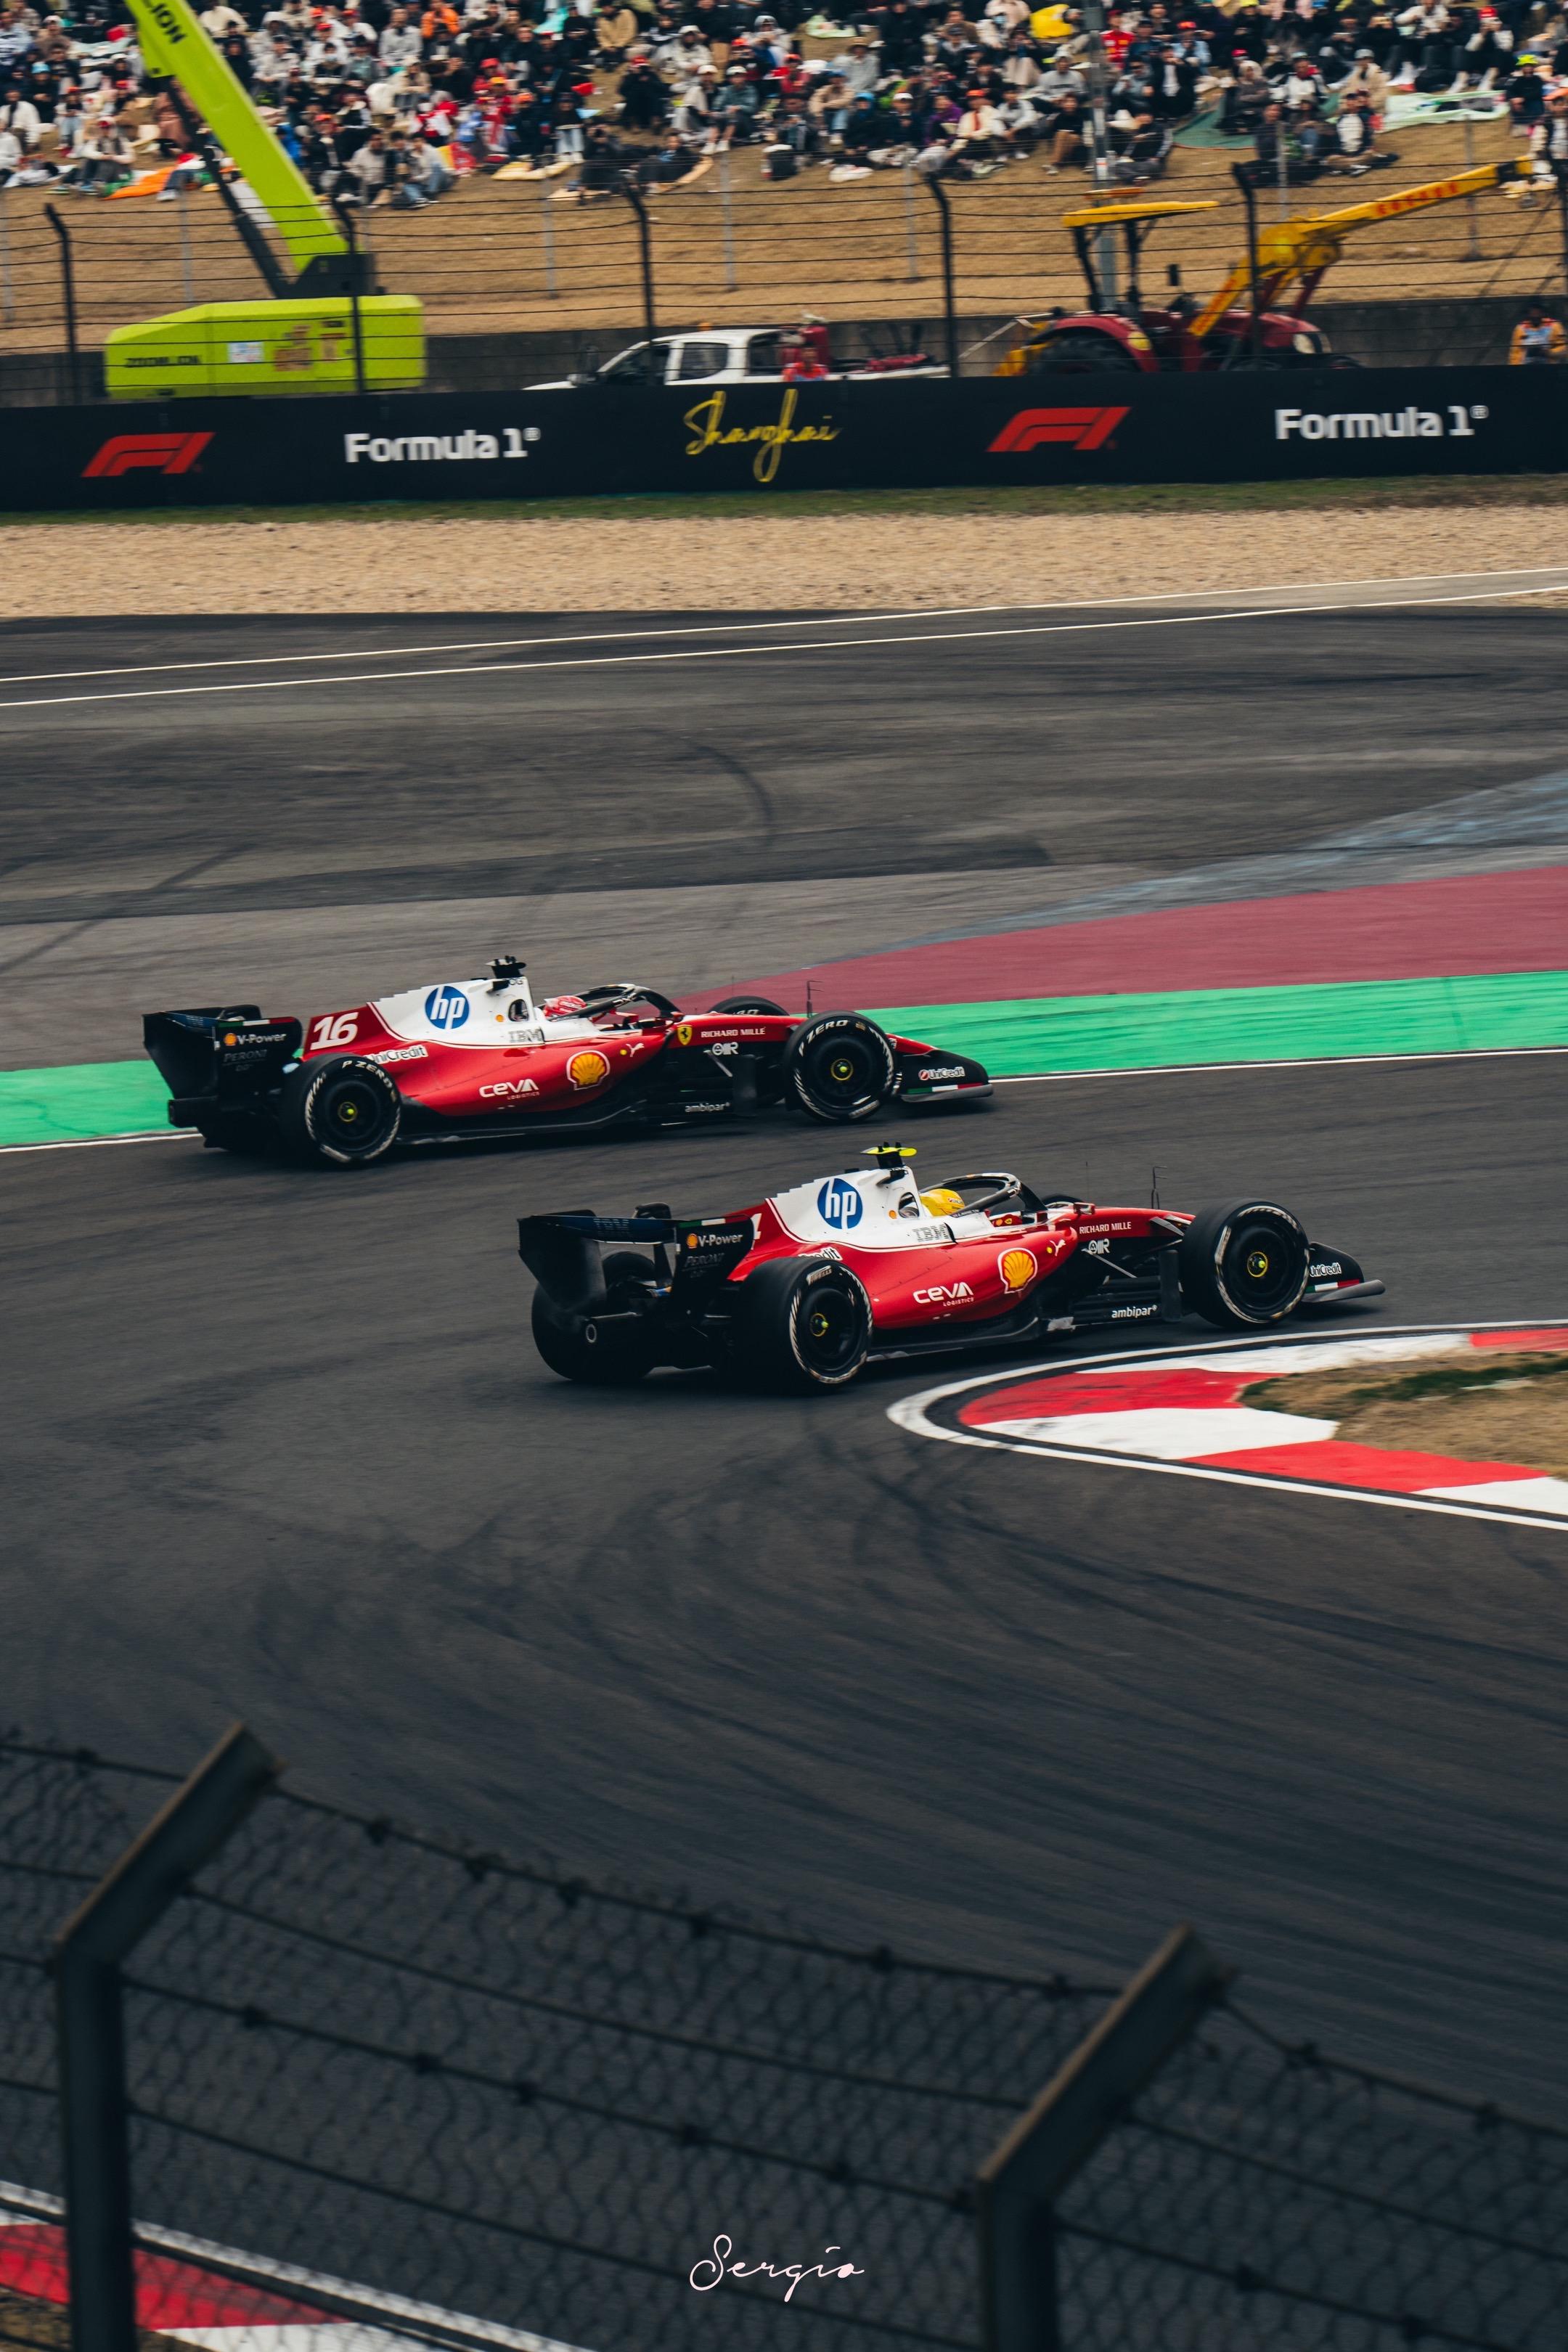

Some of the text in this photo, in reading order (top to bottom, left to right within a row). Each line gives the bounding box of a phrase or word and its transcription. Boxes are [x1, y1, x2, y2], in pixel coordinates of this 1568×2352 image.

[1275, 407, 1443, 439] Formula
[344, 430, 500, 462] Formula
[683, 389, 843, 482] Shanghai
[430, 986, 466, 1029] hp
[237, 1034, 287, 1045] V-Power
[310, 1012, 359, 1050] 16
[740, 1028, 766, 1037] MILLE
[807, 1020, 848, 1044] ZERO
[928, 1066, 965, 1080] UniCredit
[825, 1179, 857, 1230] hp
[1079, 1221, 1132, 1234] RICHARD MILLE
[698, 1234, 743, 1247] V-Power
[943, 1297, 975, 1307] LOGISTICS
